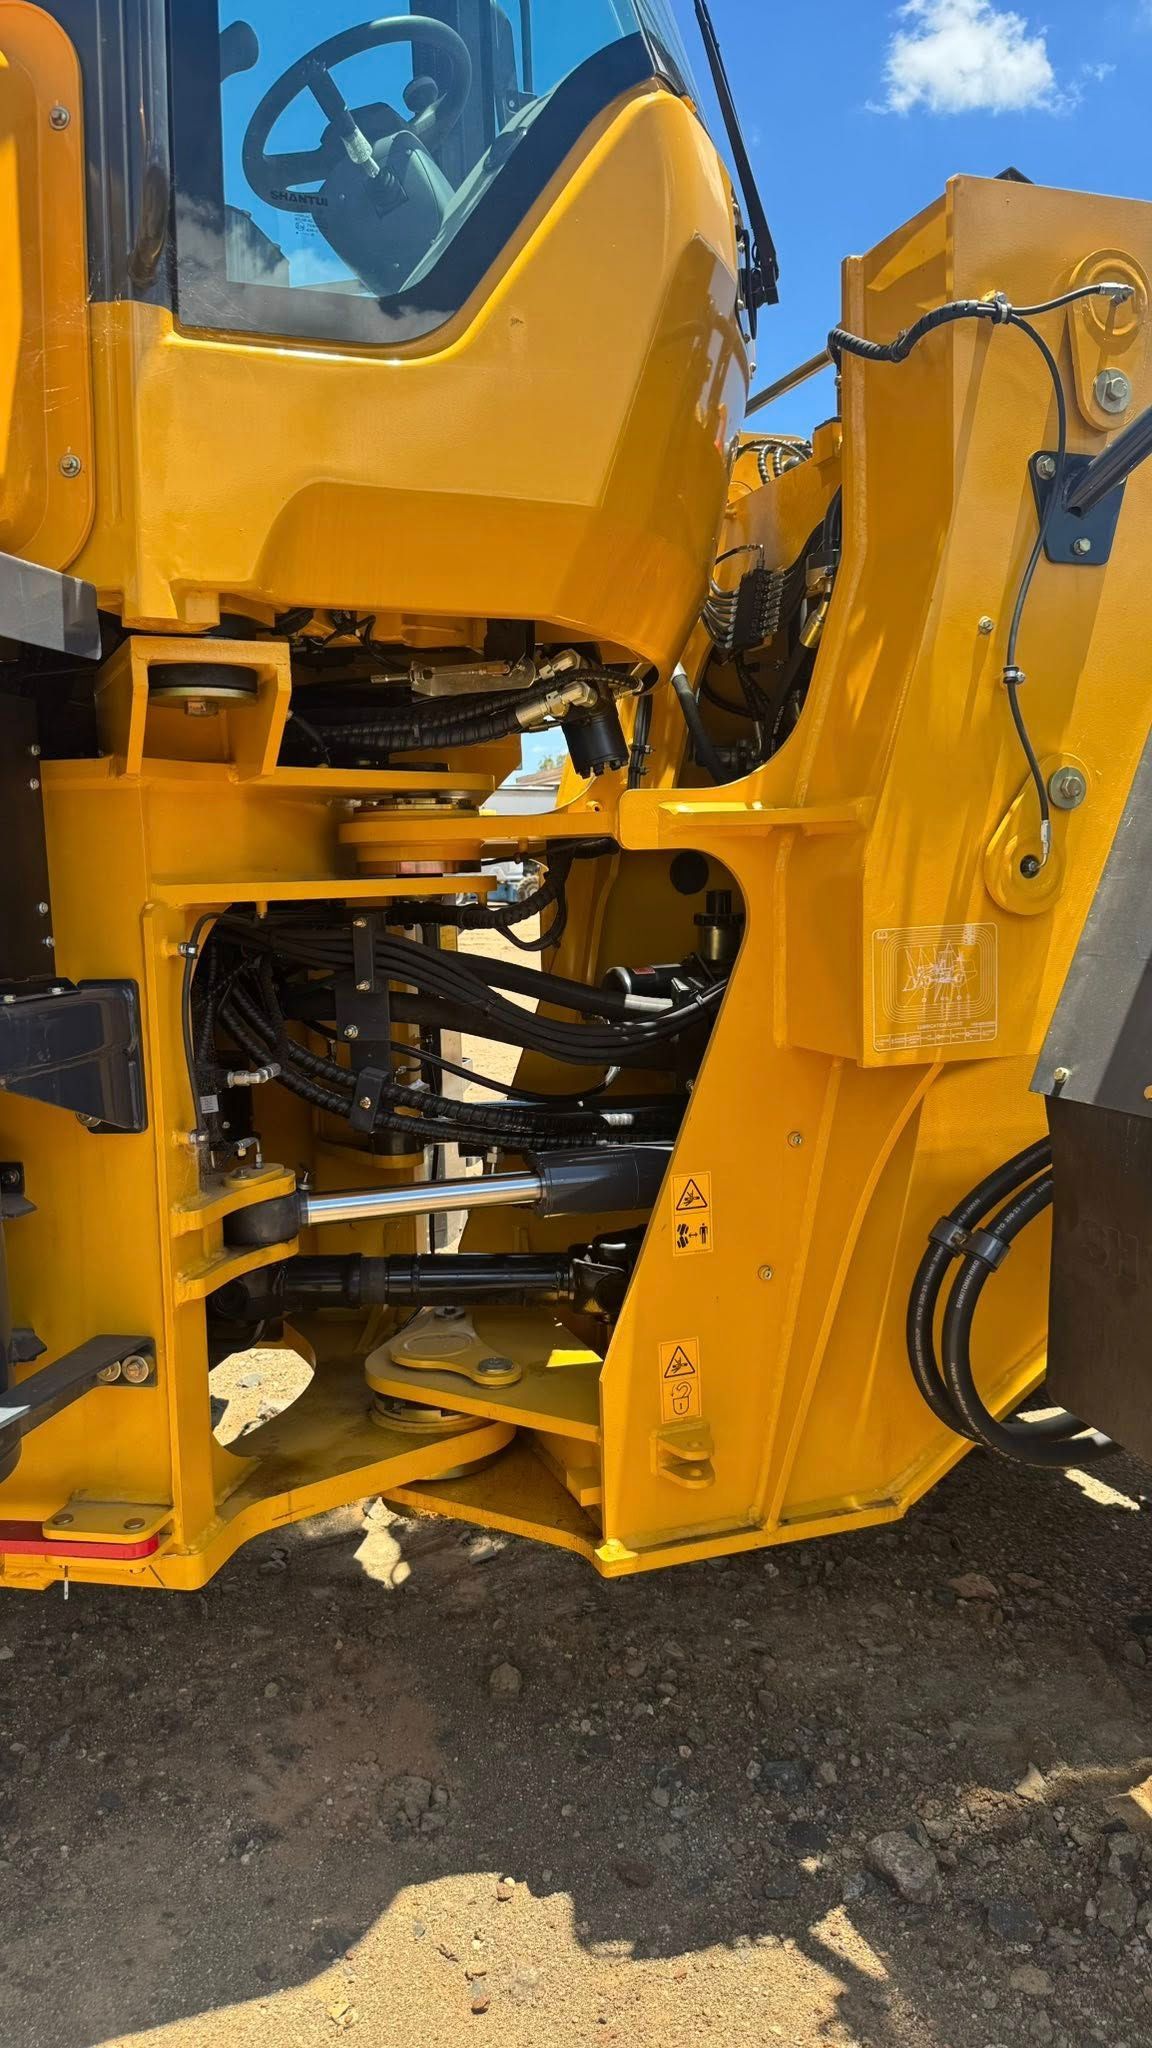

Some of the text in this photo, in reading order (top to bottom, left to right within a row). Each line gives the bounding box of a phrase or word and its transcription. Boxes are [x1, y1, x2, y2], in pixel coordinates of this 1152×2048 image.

[270, 190, 328, 206] SHANTUI
[956, 1259, 980, 1309] SUMITOMO RIKO
